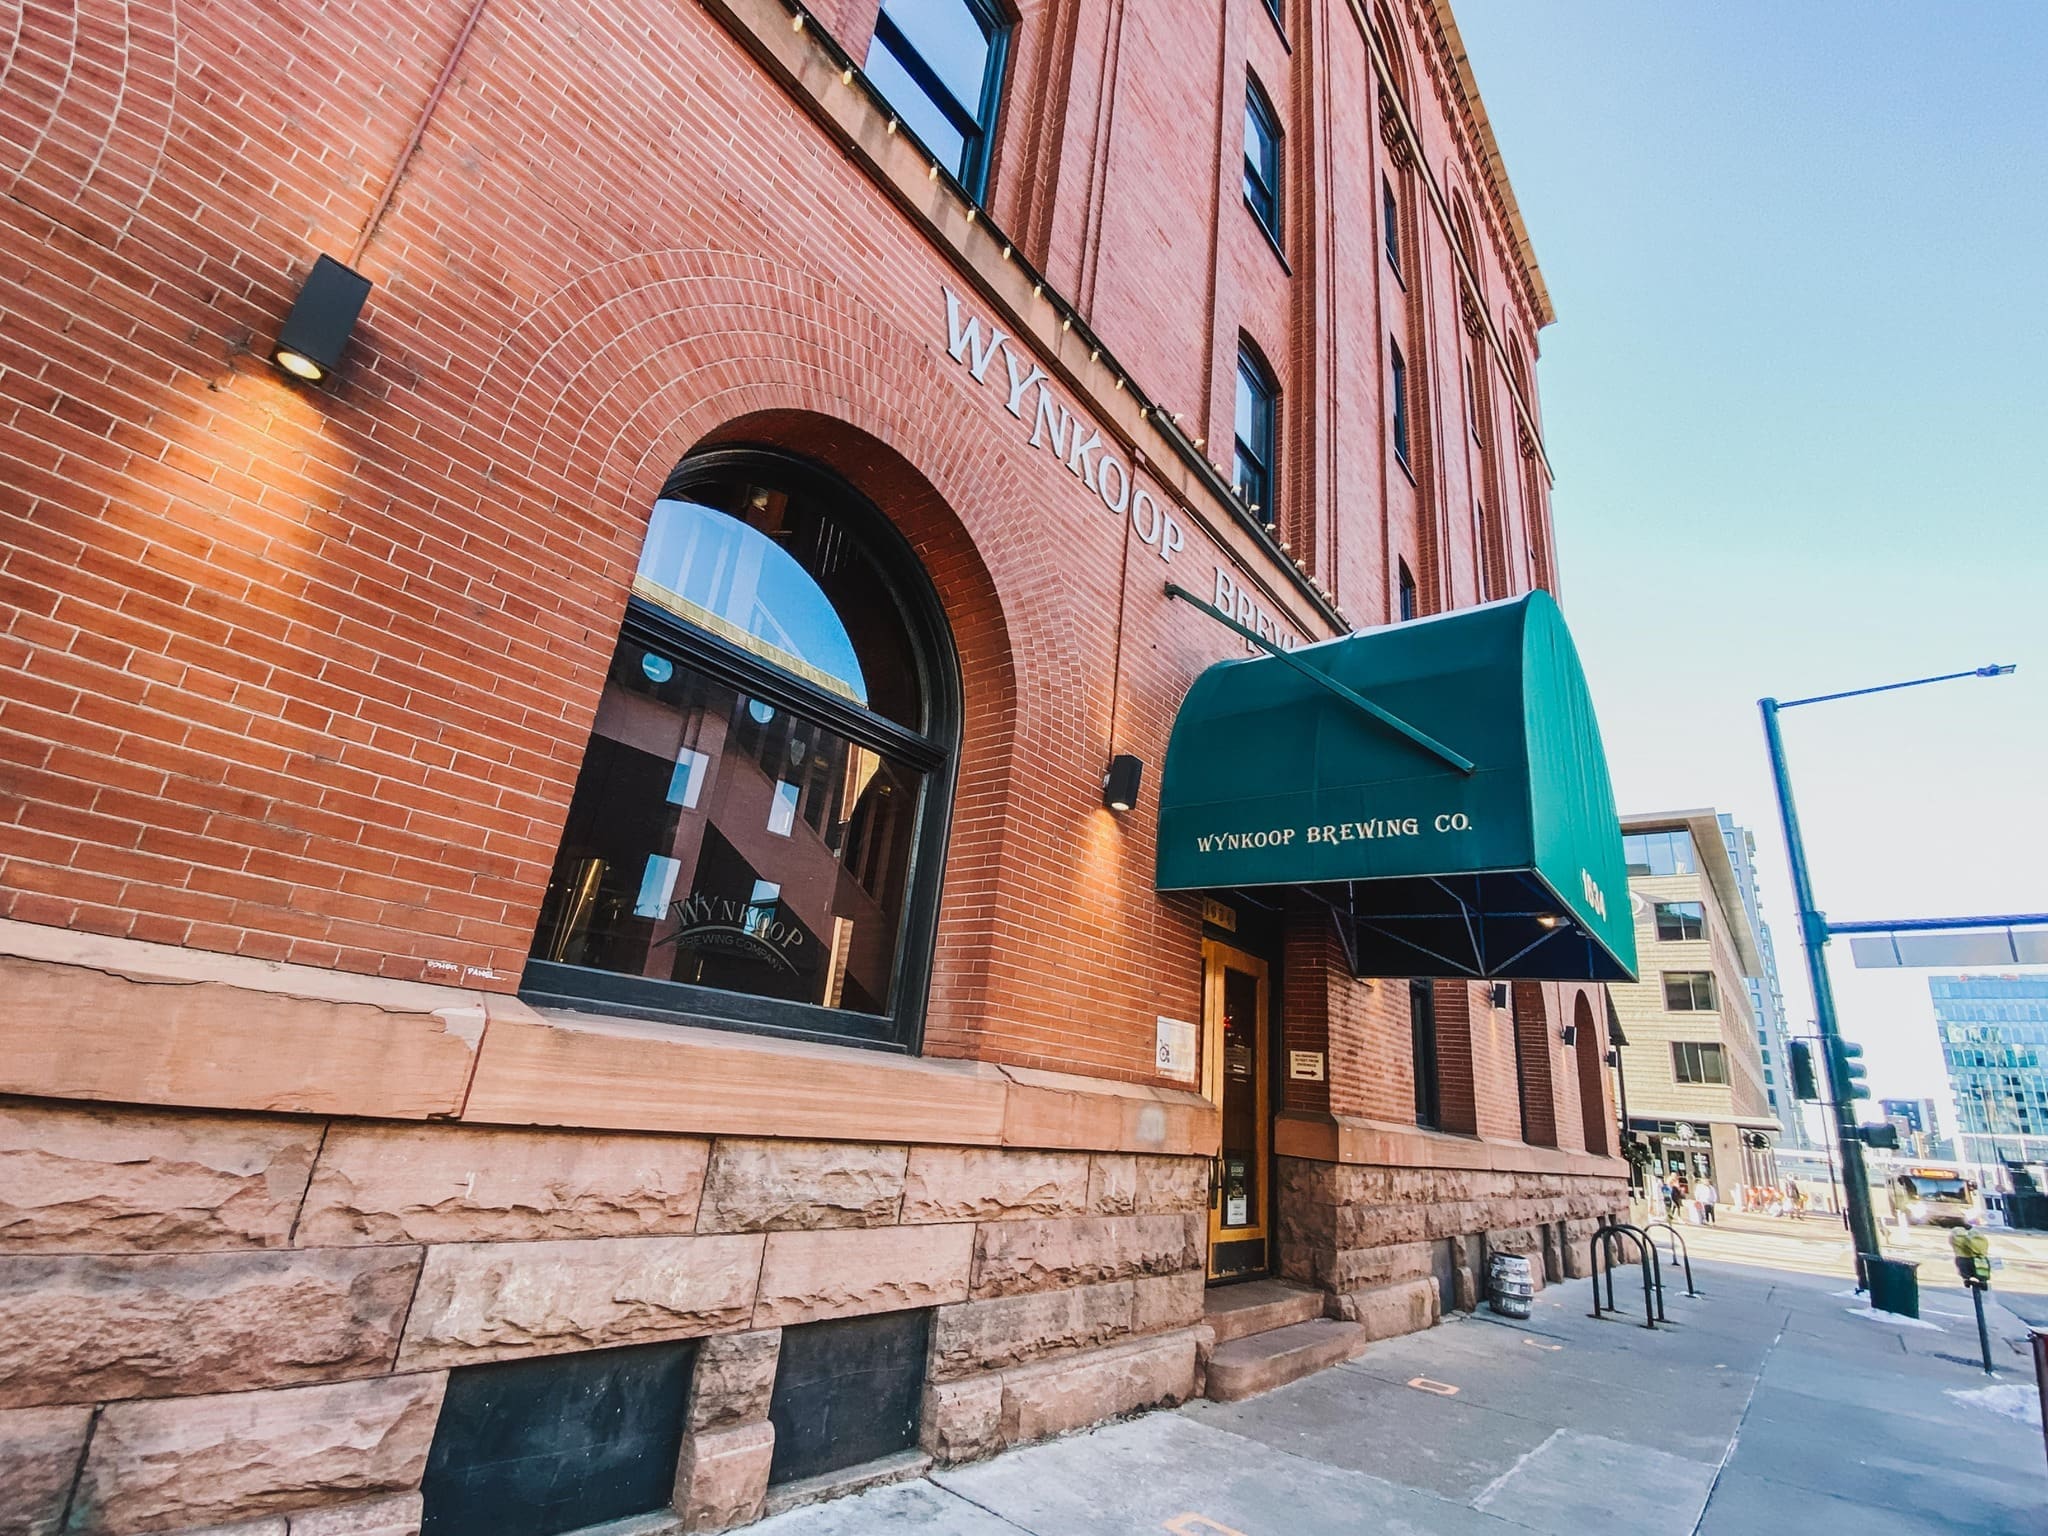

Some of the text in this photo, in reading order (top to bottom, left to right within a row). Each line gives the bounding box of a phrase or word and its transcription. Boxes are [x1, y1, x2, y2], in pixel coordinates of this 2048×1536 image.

[941, 285, 1185, 565] WYNKOOP
[1197, 812, 1473, 853] WYNKOOP BREWING CO.
[671, 890, 804, 949] WYNKOOP
[677, 934, 785, 974] BREWING COMPANY
